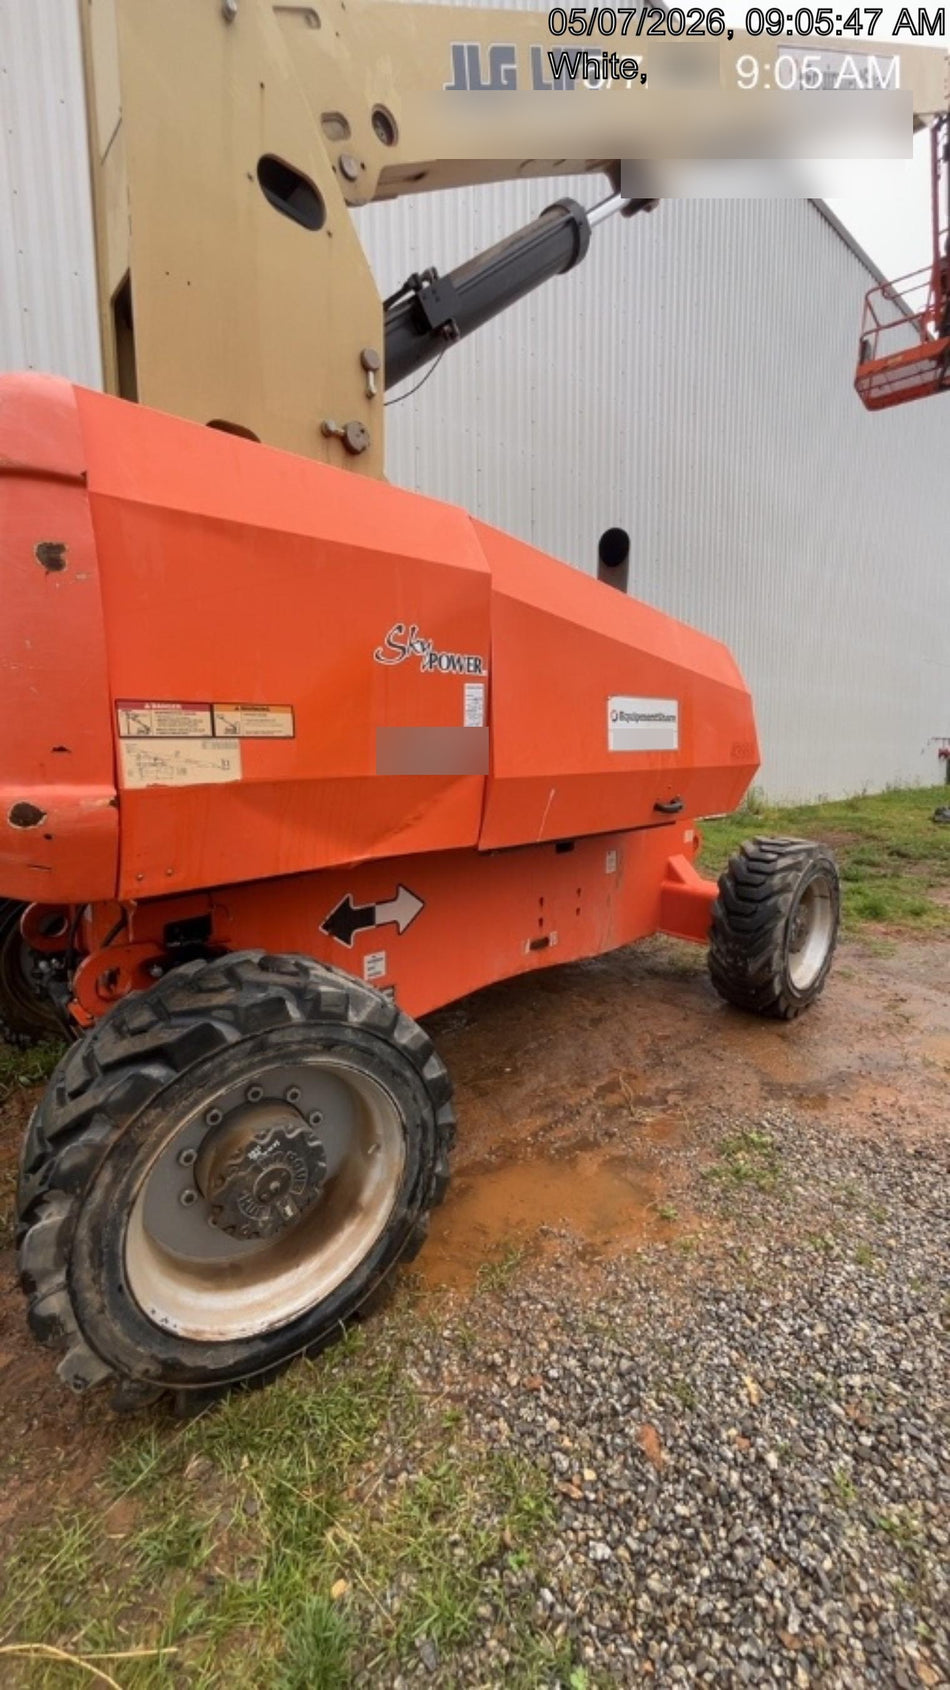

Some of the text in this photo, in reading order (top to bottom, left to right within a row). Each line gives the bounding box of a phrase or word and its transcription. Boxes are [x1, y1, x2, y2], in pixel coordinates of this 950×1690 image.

[443, 42, 517, 90] JLG
[373, 623, 483, 674] Sky POWER
